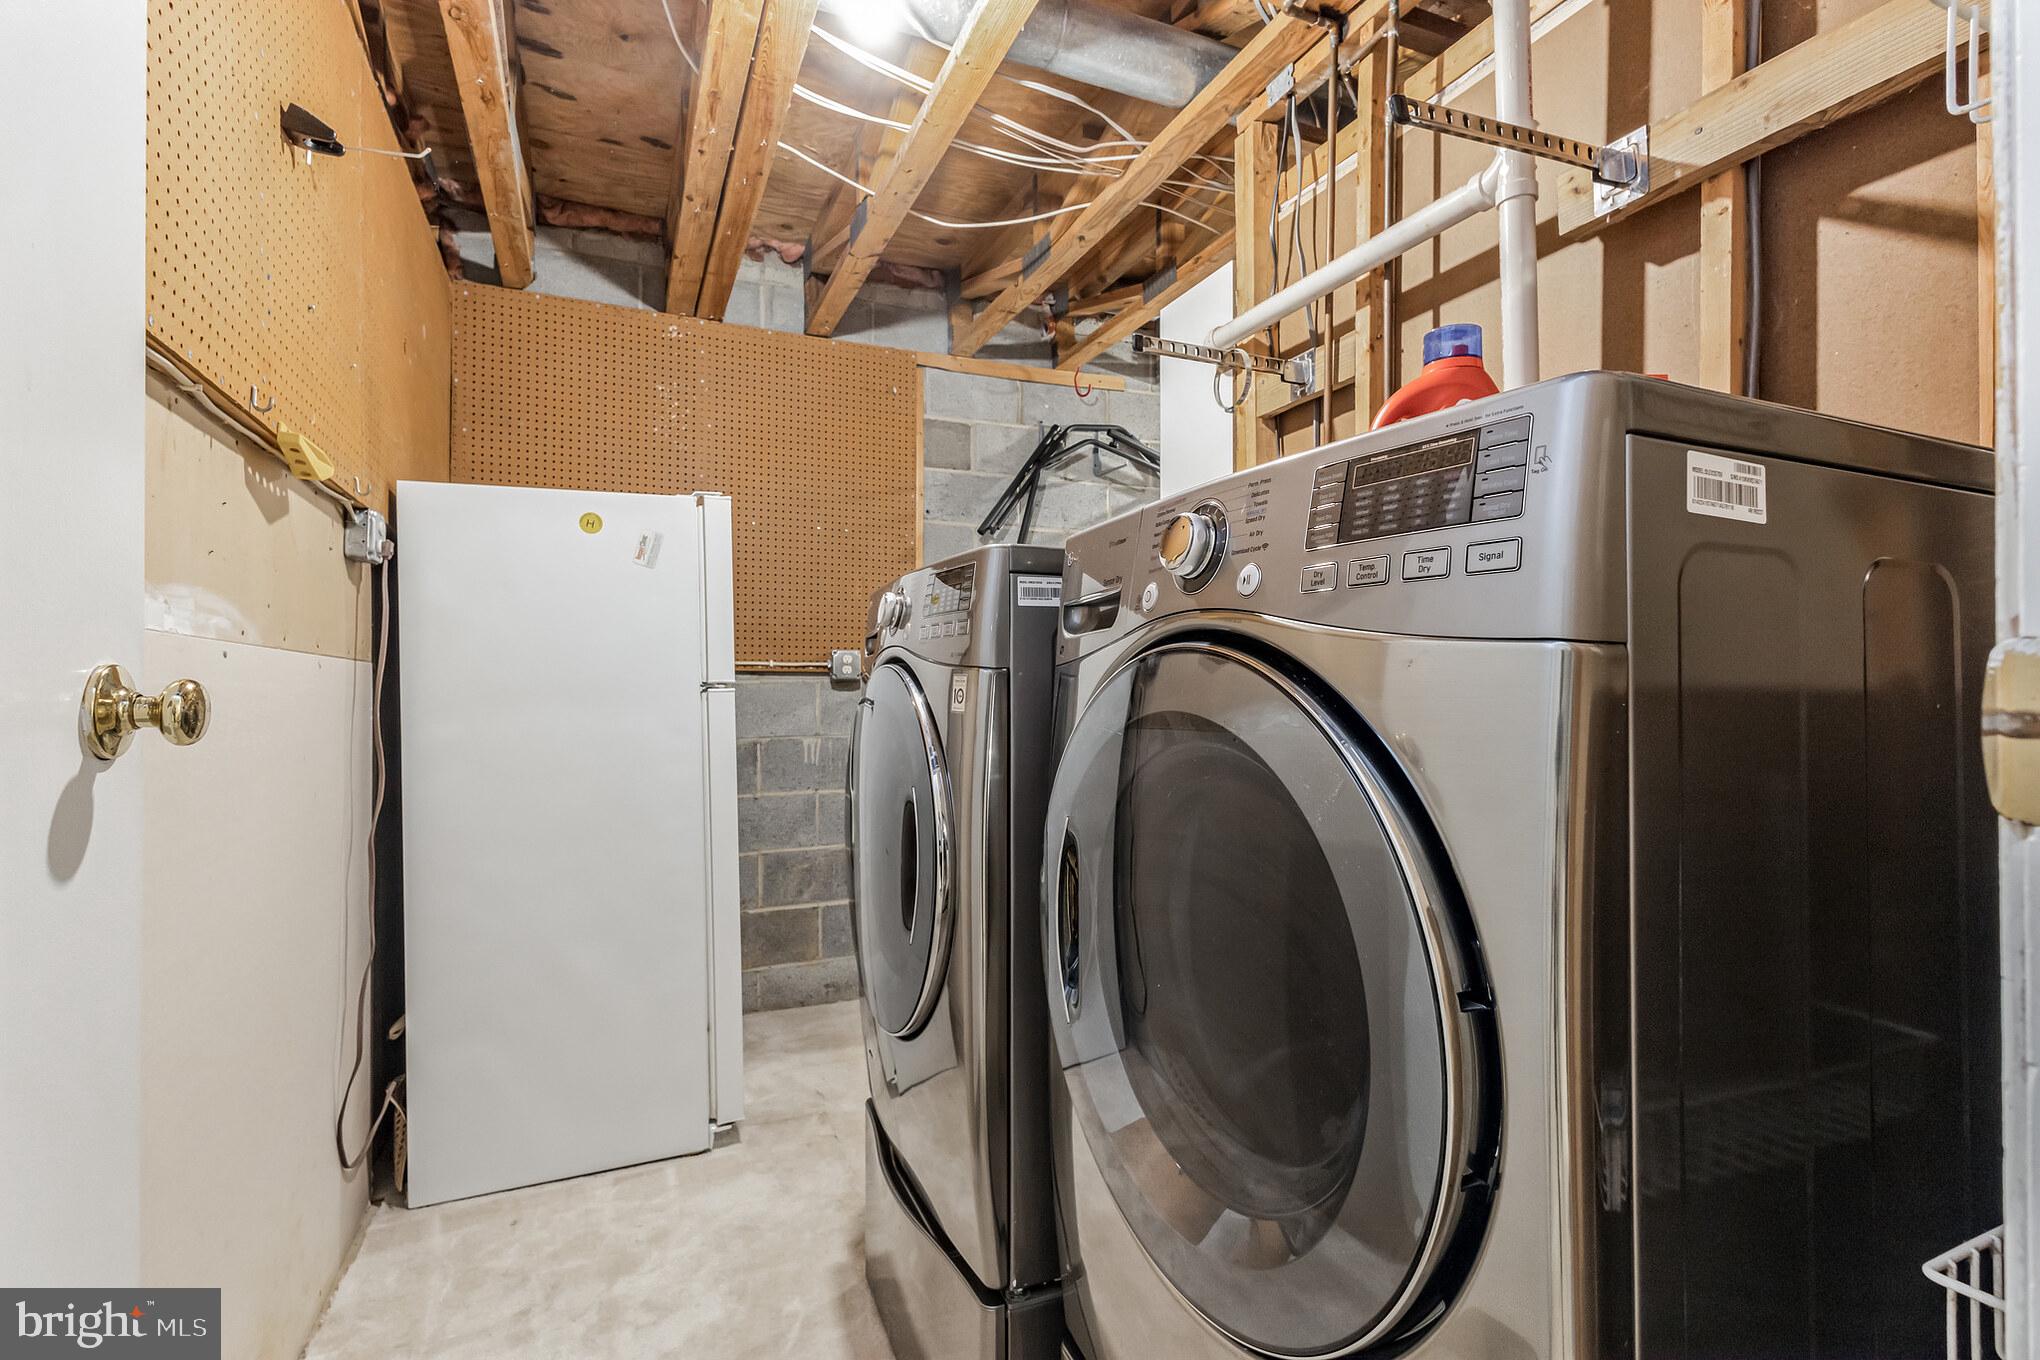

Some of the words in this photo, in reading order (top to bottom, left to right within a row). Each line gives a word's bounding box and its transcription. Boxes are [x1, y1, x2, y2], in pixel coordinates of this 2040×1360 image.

[1417, 555, 1434, 564] Time
[1478, 550, 1504, 562] Signal
[1418, 565, 1432, 574] Dry
[1313, 570, 1324, 579] Dry
[1355, 571, 1379, 581] Control
[1310, 578, 1326, 587] Level
